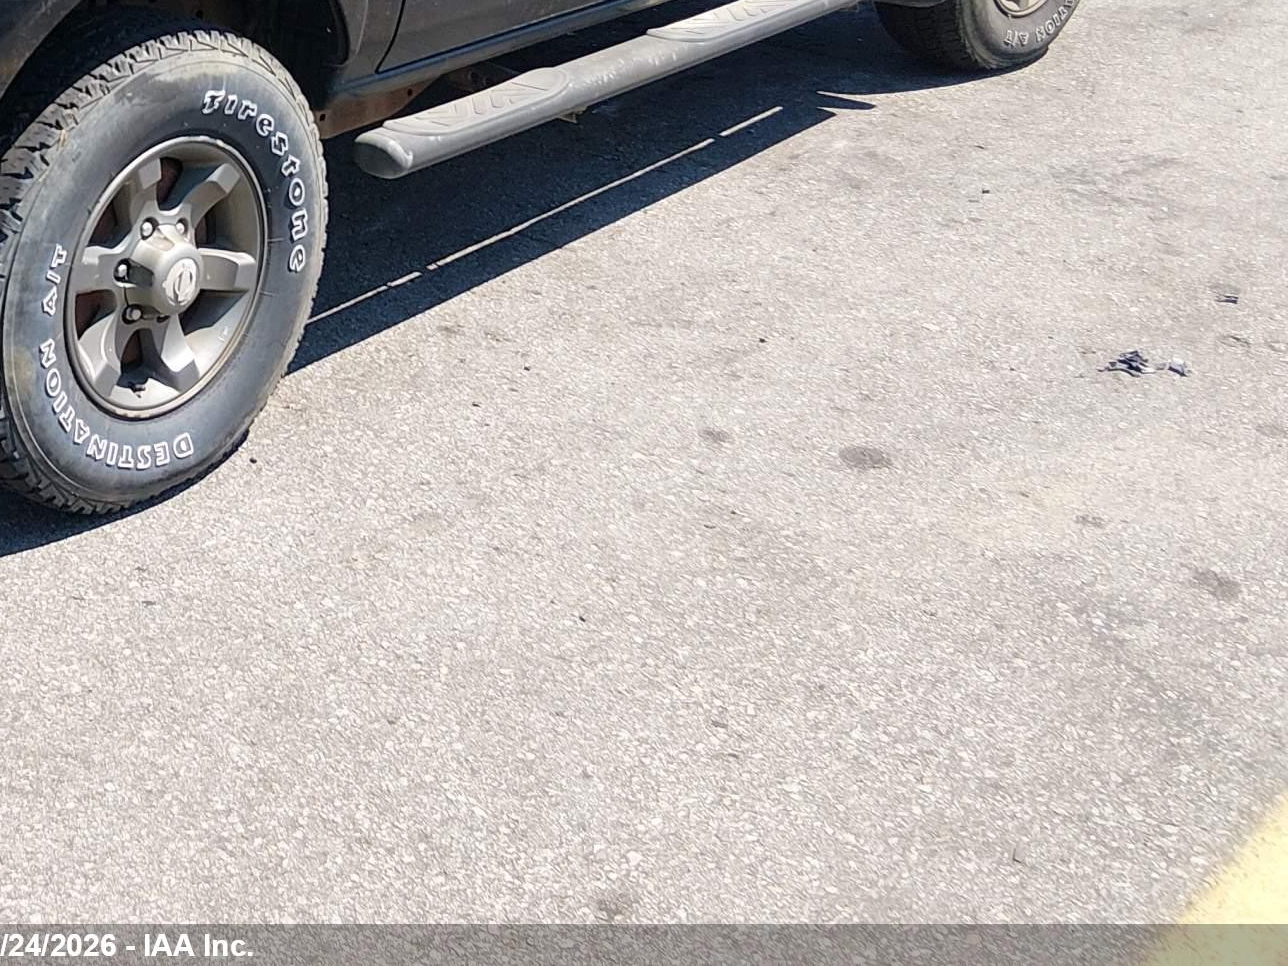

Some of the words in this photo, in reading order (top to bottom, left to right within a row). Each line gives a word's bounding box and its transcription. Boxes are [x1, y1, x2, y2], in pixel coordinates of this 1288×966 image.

[202, 90, 308, 272] Firestone
[41, 243, 68, 318] A/T
[39, 337, 194, 470] DESTINATION
